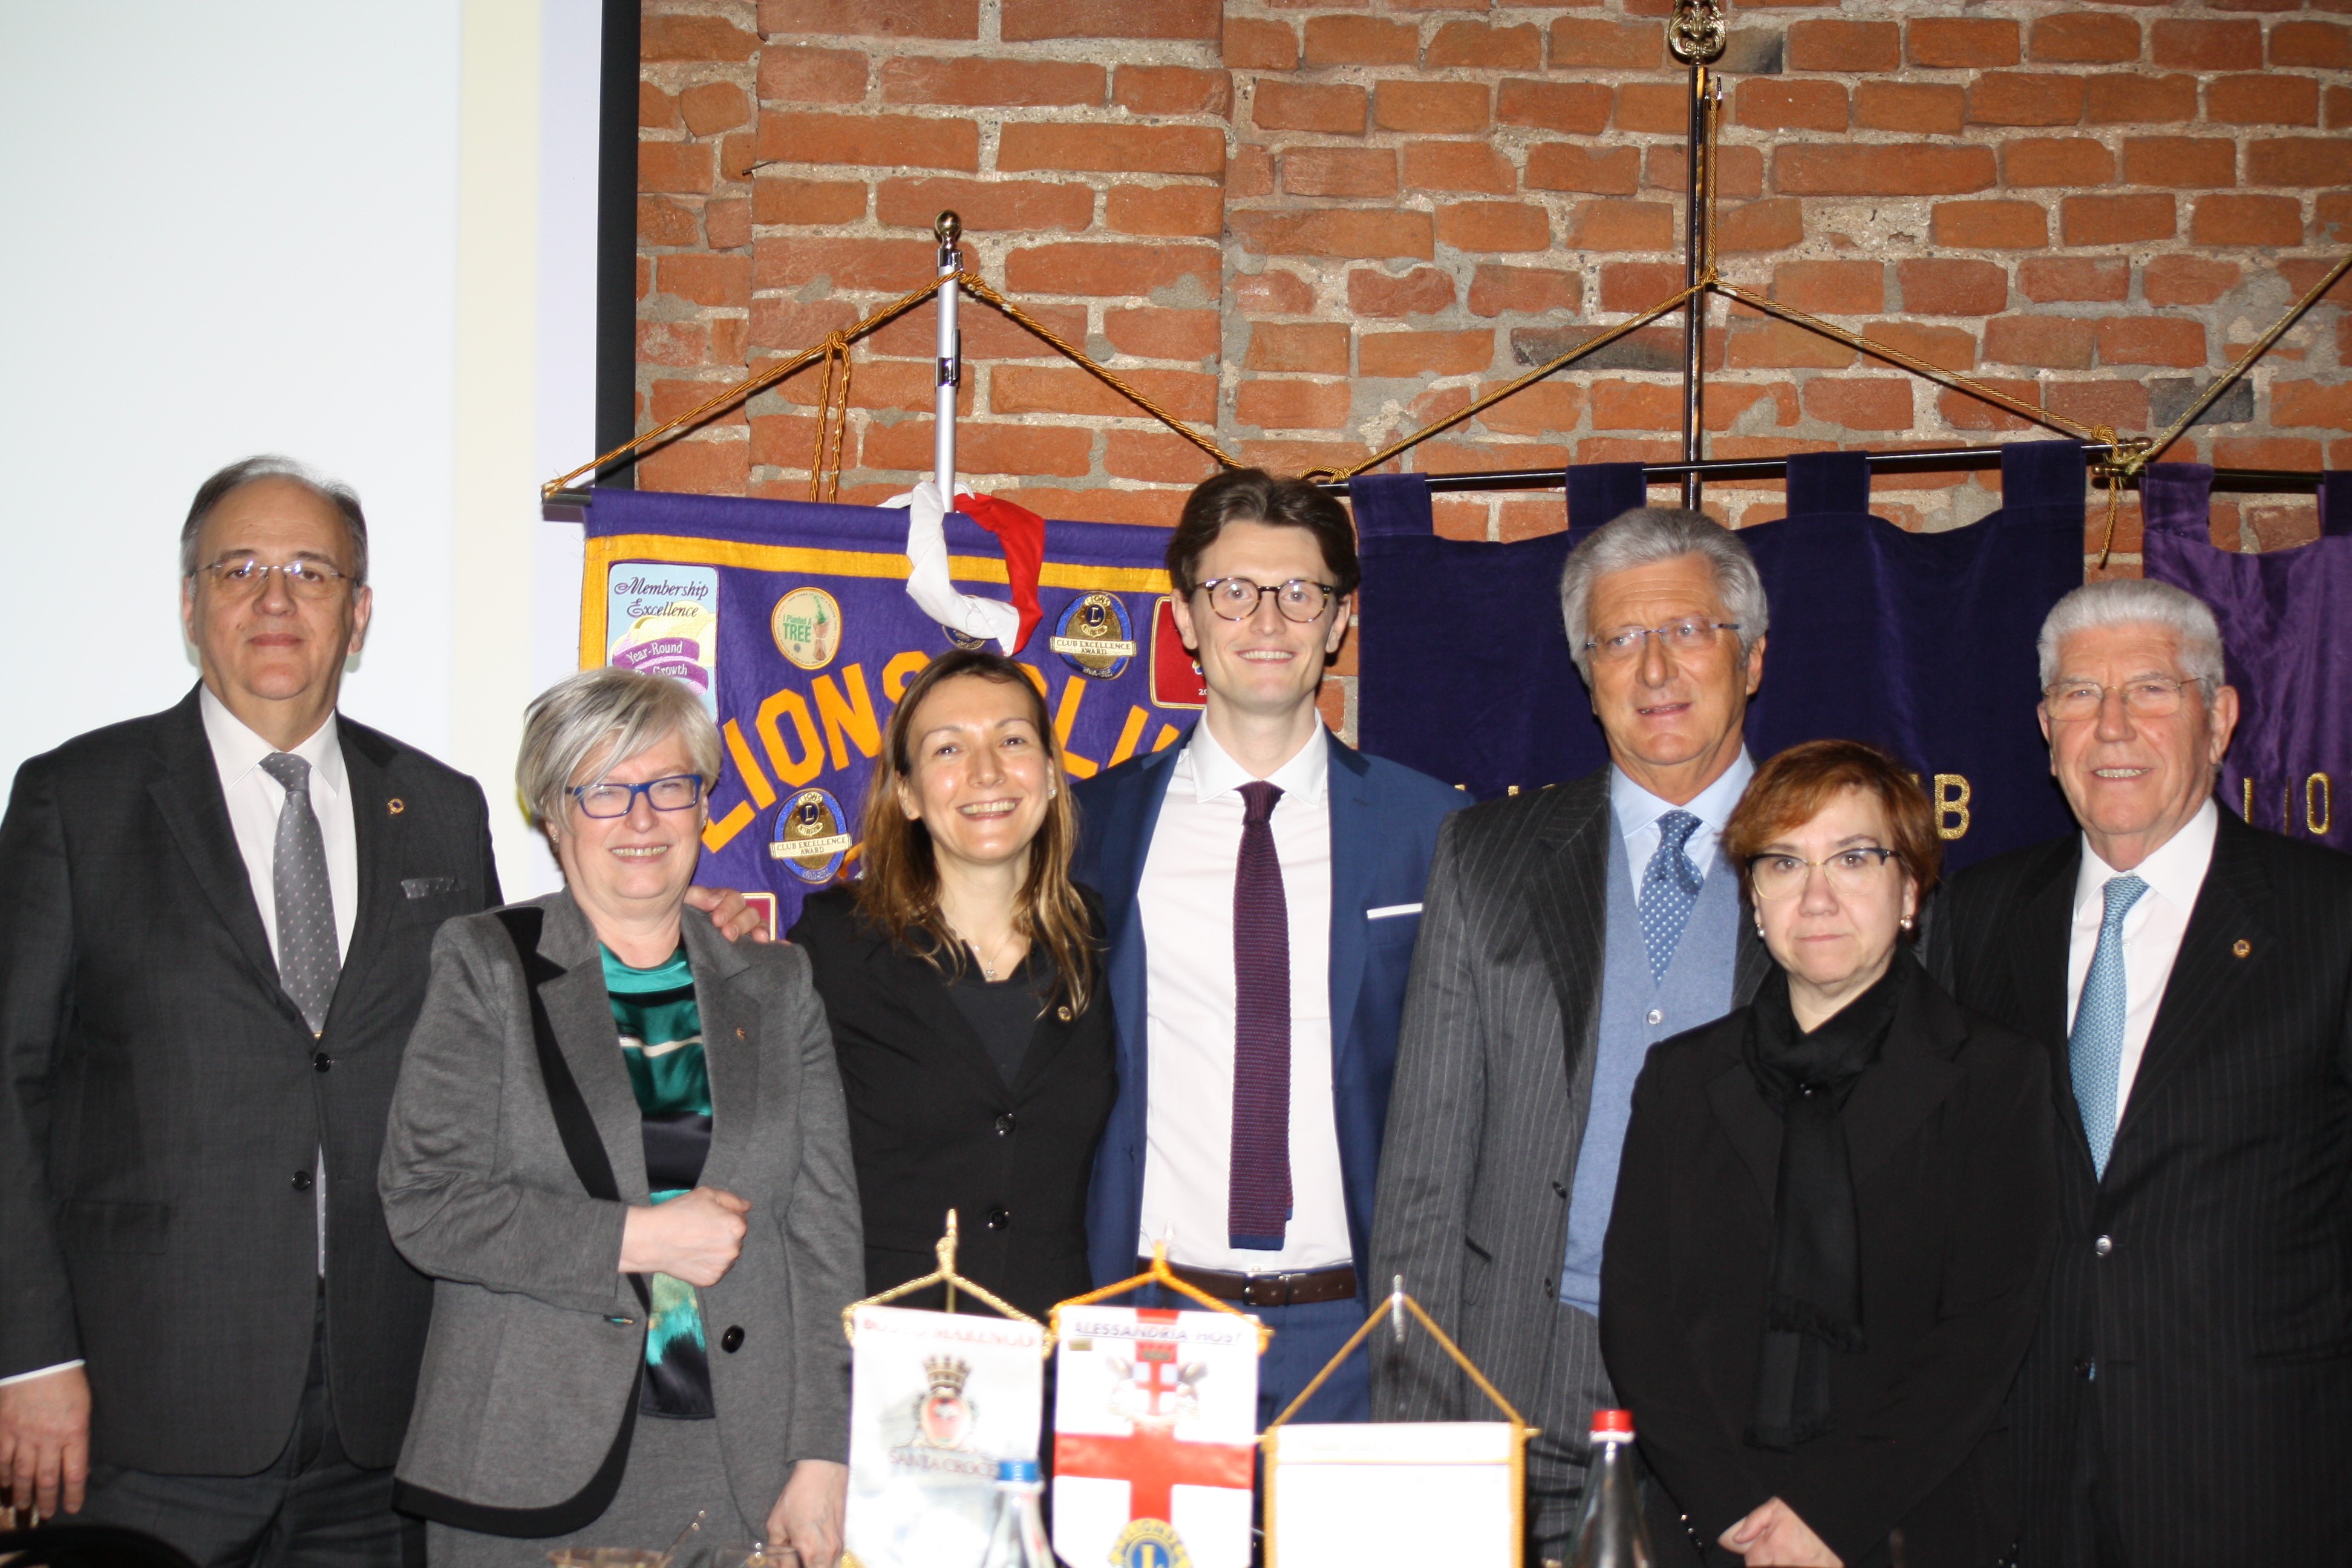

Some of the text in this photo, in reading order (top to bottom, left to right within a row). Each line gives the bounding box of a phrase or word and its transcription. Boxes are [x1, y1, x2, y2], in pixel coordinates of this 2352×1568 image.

[613, 576, 709, 601] Membership
[627, 598, 699, 618] Excellence
[1086, 595, 1111, 606] LIONS
[786, 614, 807, 624] Planted
[808, 617, 812, 626] A
[1090, 607, 1101, 623] L
[783, 622, 812, 643] TREE
[626, 640, 684, 664] Year-Round
[1080, 641, 1131, 650] EXCELLENCE
[653, 663, 688, 677] Growth
[800, 792, 823, 805] LIONS
[805, 805, 815, 822] L
[799, 837, 846, 848] EXCELLENCE
[800, 846, 825, 855] AWARD
[1074, 1321, 1187, 1341] ALESSANDRIA
